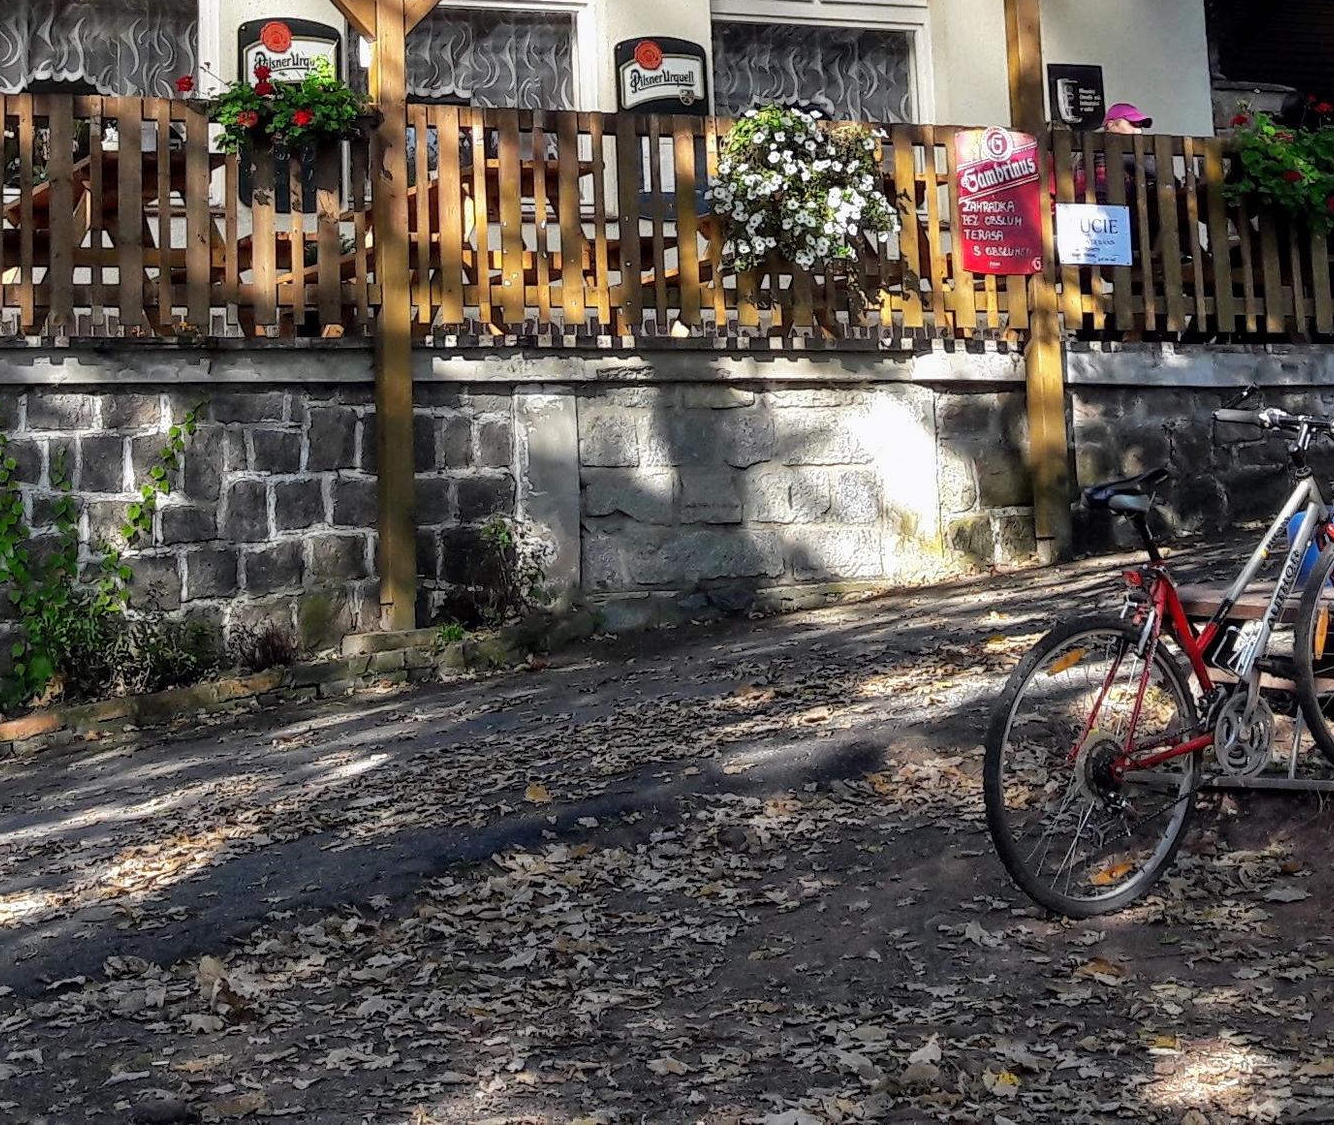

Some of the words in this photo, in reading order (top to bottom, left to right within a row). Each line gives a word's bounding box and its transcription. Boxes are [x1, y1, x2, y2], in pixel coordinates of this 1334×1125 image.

[630, 69, 663, 94] Pilsner
[662, 69, 695, 88] Urquell
[960, 156, 1036, 193] Gambrinus
[1079, 218, 1119, 235] UCIE
[1267, 548, 1300, 631] AUTHOR
